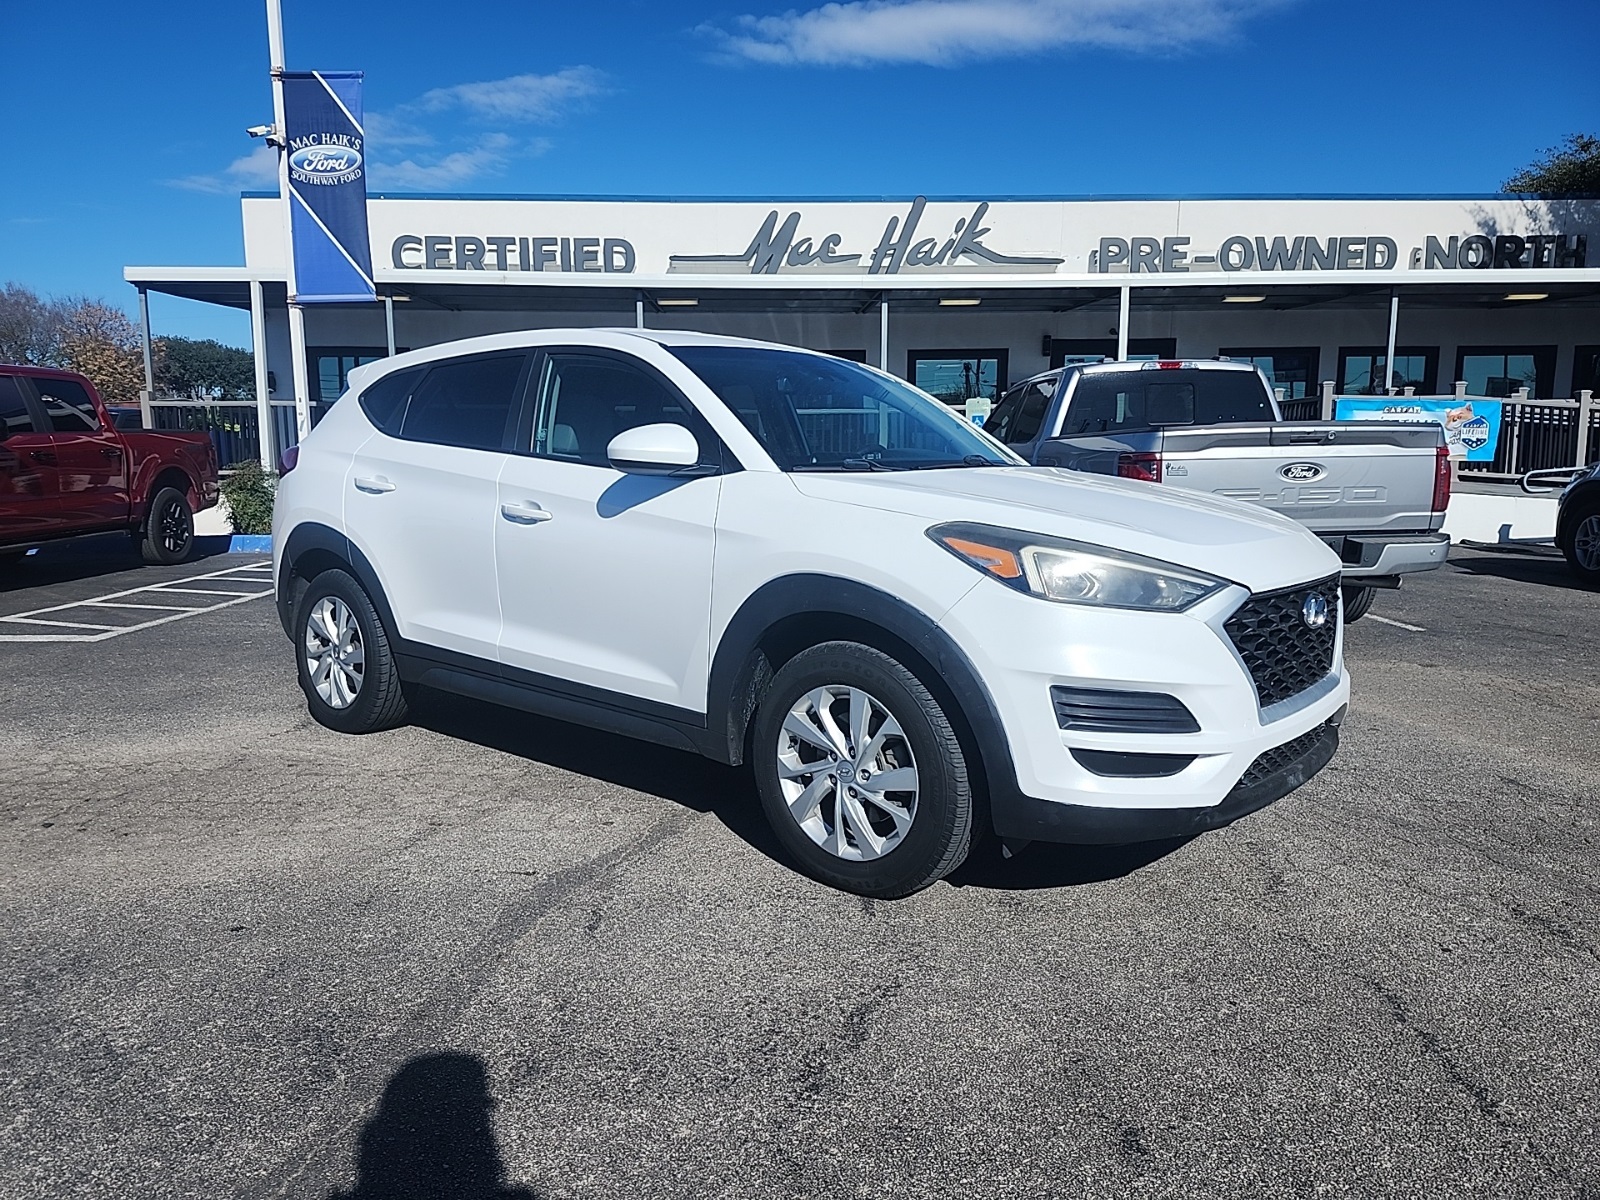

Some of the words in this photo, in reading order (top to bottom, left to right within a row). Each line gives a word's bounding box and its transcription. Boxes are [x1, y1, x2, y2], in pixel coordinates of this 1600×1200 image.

[289, 134, 317, 150] MAC
[321, 133, 362, 150] HAIK'S
[303, 150, 348, 170] Ford
[291, 170, 339, 186] SOUTHWAY
[340, 169, 362, 184] FORD
[669, 210, 862, 274] Mac
[868, 195, 1065, 274] Haik
[391, 234, 636, 274] CERTIFIED
[1098, 236, 1397, 273] PRE-OWNED
[1424, 235, 1588, 269] NORTH
[1383, 406, 1421, 414] CARFAX
[1287, 463, 1318, 480] Ford
[1211, 486, 1388, 505] F-150
